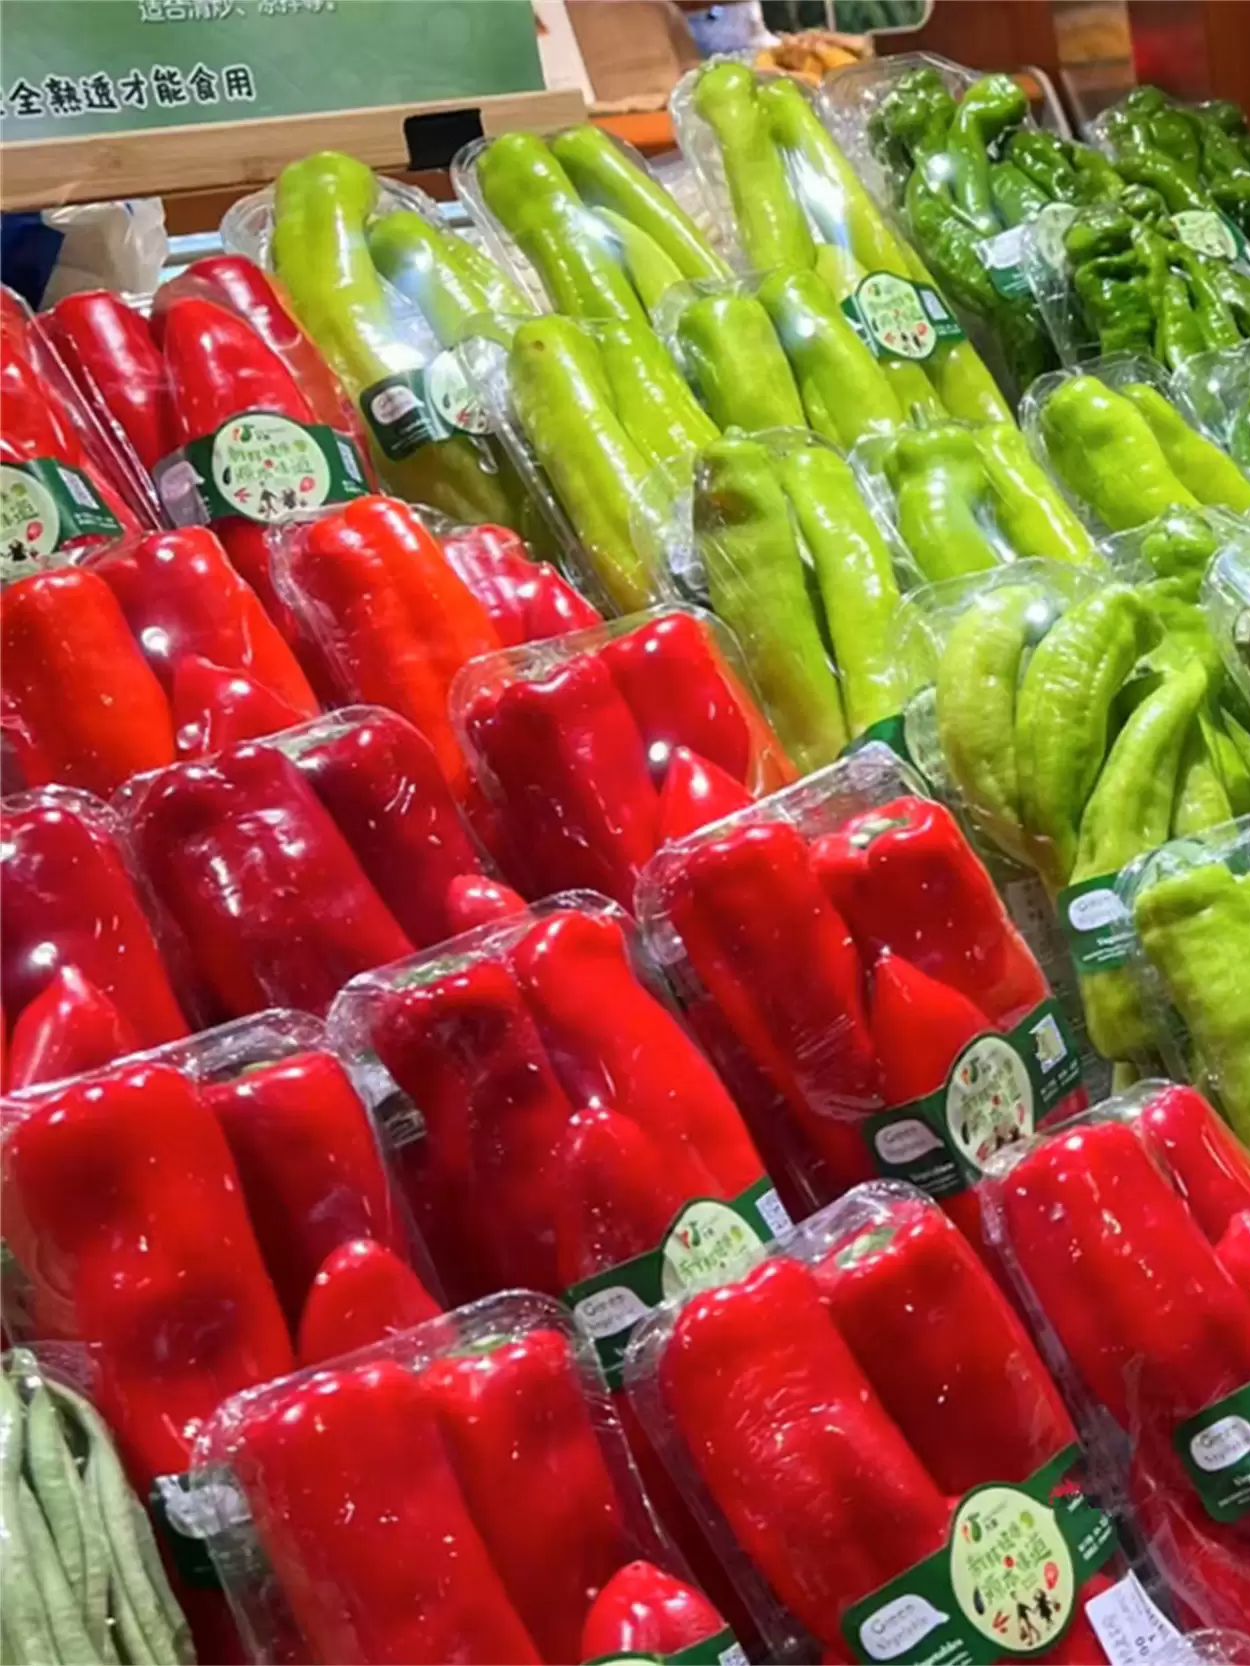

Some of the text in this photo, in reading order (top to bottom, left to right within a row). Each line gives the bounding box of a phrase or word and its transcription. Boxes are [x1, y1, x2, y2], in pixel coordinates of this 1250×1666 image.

[0, 63, 255, 115] 全熟透才能食用
